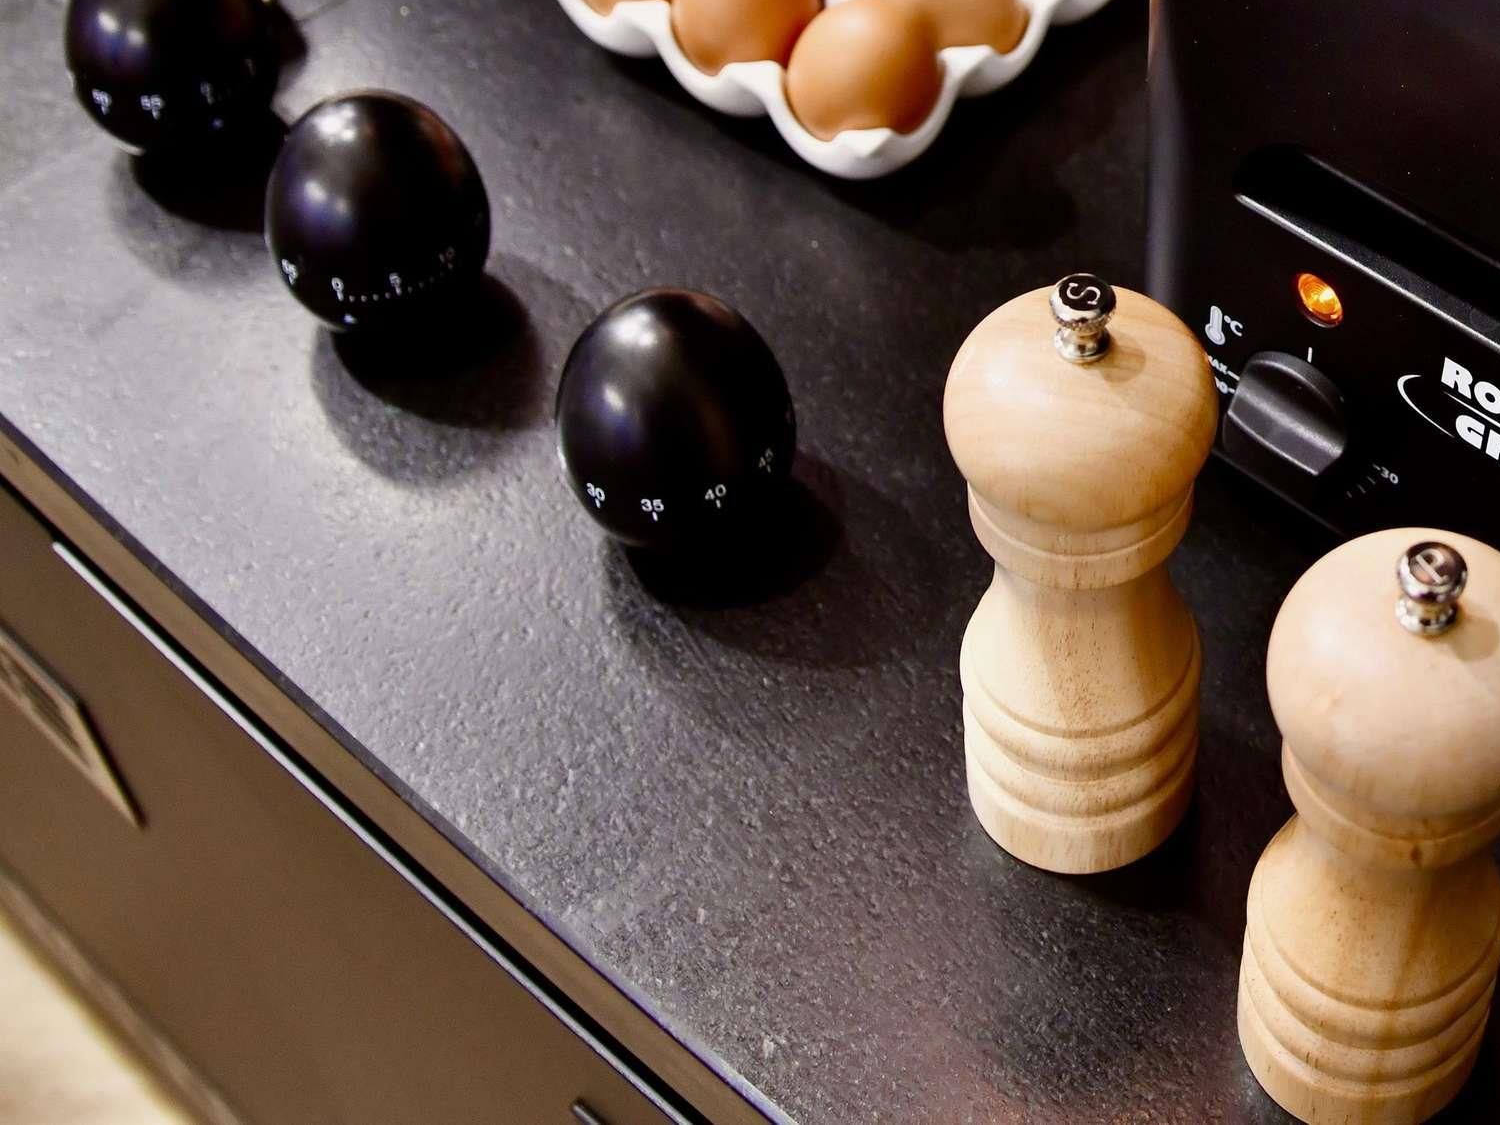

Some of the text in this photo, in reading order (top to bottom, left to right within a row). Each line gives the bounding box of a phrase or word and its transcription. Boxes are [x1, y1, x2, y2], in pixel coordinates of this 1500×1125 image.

[1066, 282, 1101, 306] S
[587, 482, 606, 502] 30
[640, 498, 665, 513] 35
[704, 483, 727, 501] 40
[1415, 548, 1445, 585] P
